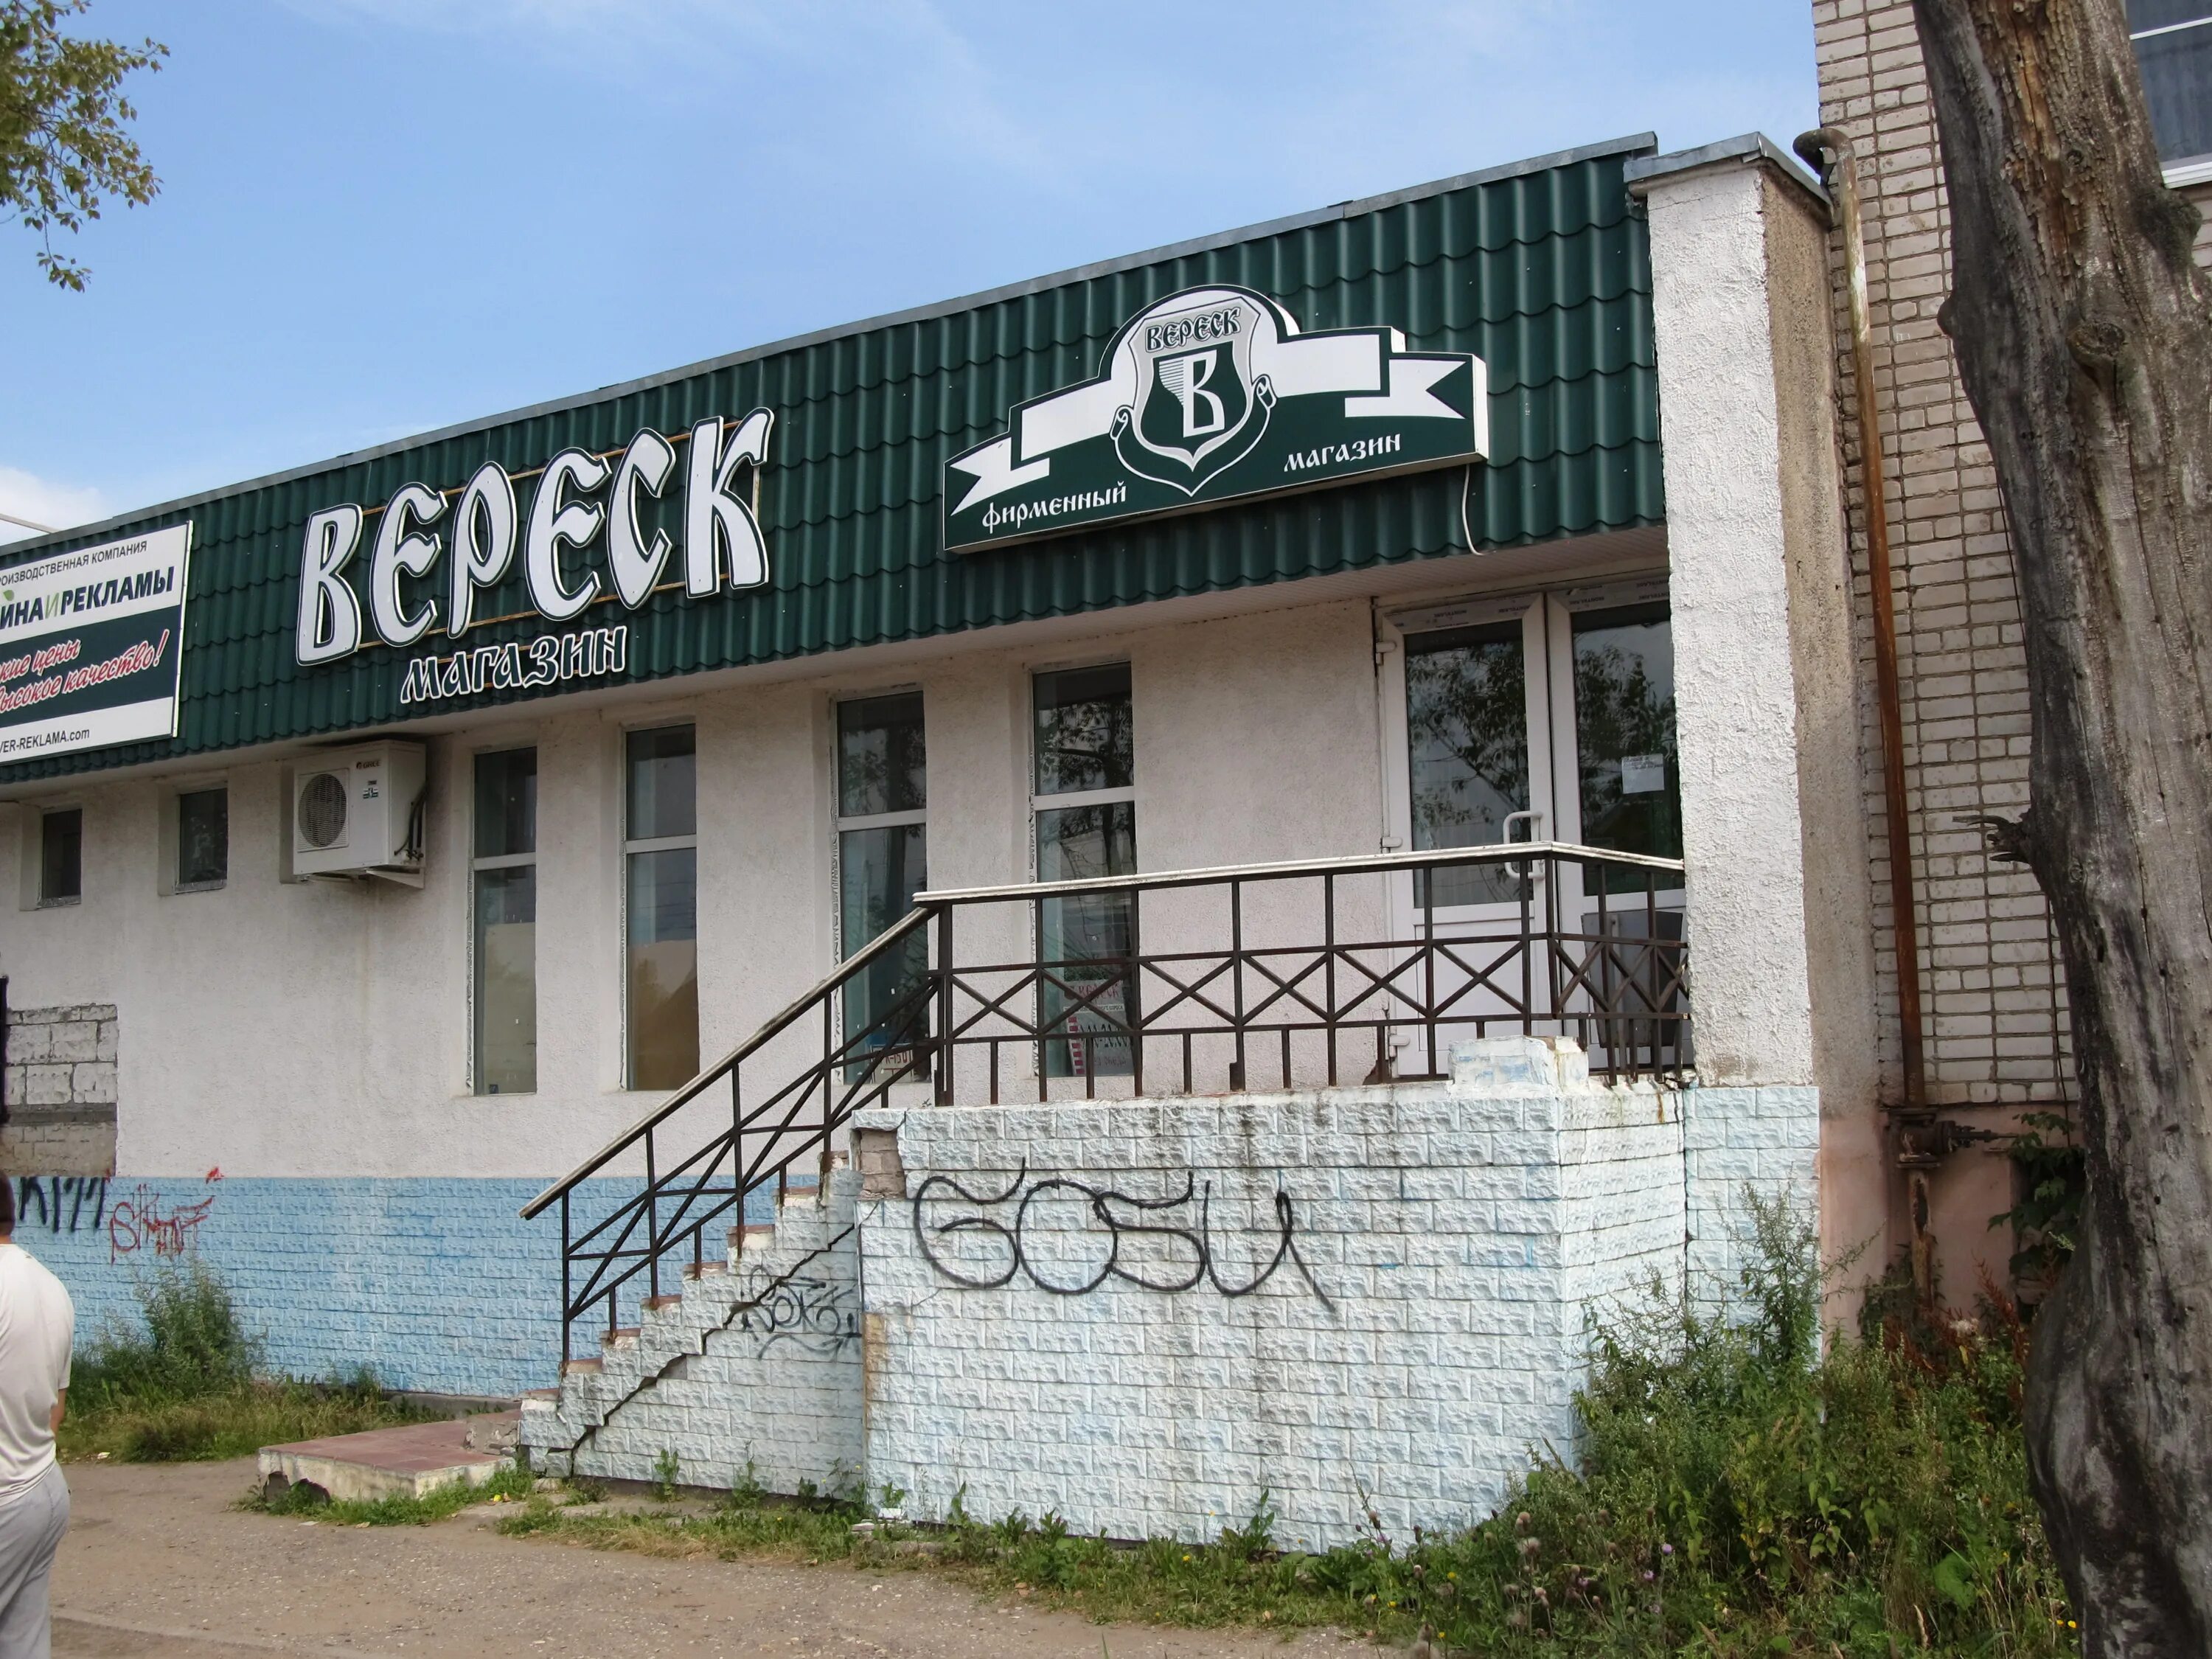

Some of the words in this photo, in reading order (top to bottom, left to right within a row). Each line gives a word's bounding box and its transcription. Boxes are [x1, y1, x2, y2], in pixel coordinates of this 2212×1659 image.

[1145, 307, 1241, 352] ВЕРЕСК
[982, 481, 1127, 535] фирменный
[296, 406, 774, 667] ВЕРЕСК
[0, 554, 89, 586] ОИЗВОДСТВЕННАЯ
[91, 540, 147, 564] КОМПАНИЯ
[32, 639, 81, 676] цены
[62, 629, 170, 695] качество!
